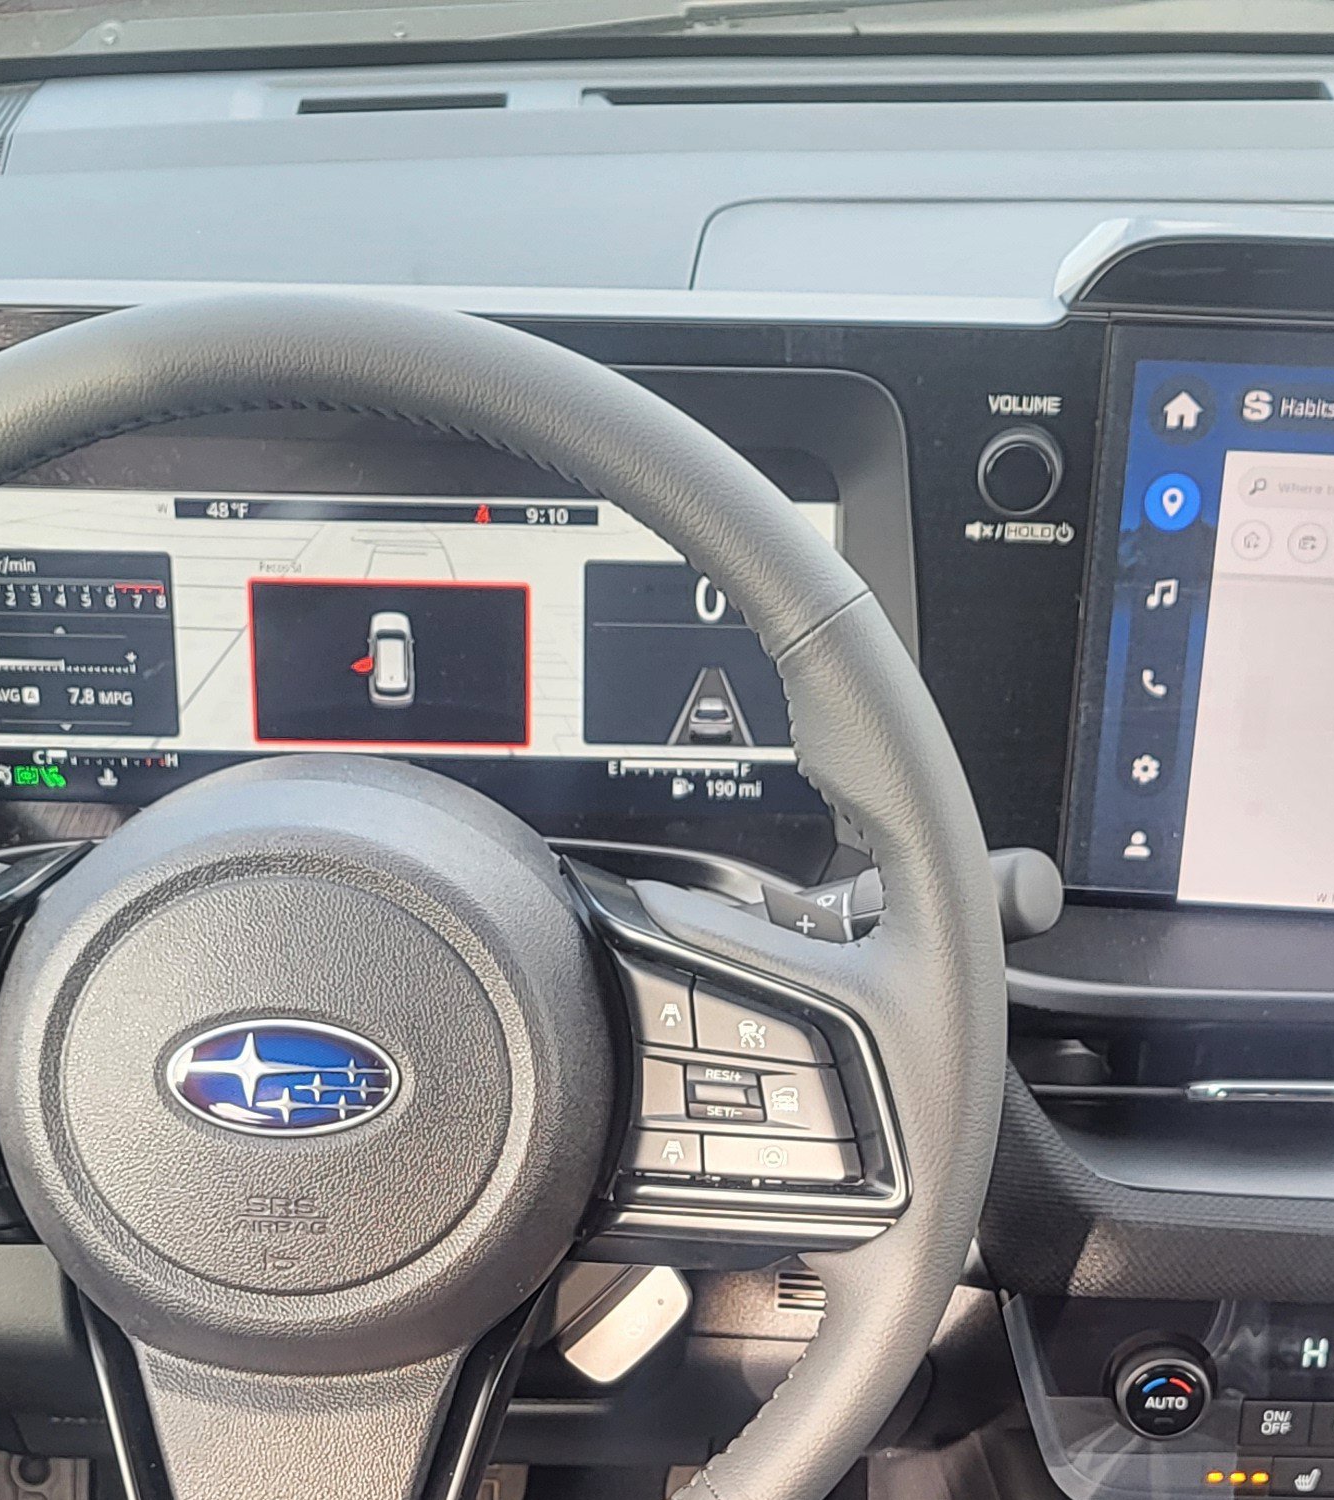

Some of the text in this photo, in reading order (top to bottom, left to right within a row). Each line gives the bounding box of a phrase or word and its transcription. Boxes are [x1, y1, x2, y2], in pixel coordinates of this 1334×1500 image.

[988, 394, 1062, 415] VOLUME
[525, 507, 569, 525] 9:10
[1006, 523, 1053, 539] HOLD
[5, 592, 17, 610] 2
[30, 592, 42, 610] 3
[55, 592, 67, 610] 4
[80, 592, 92, 610] 5
[105, 592, 117, 610] 6
[133, 592, 143, 610] 7
[155, 592, 167, 610] 8
[695, 574, 727, 623] 0
[67, 687, 95, 705] 7.8
[98, 690, 134, 706] MPG
[609, 761, 619, 776] E
[705, 779, 763, 798] 190 mi
[246, 1197, 316, 1214] SRS
[229, 1220, 327, 1235] AIRBAG
[1144, 1396, 1188, 1411] AUTO
[1261, 1422, 1292, 1435] OFF
